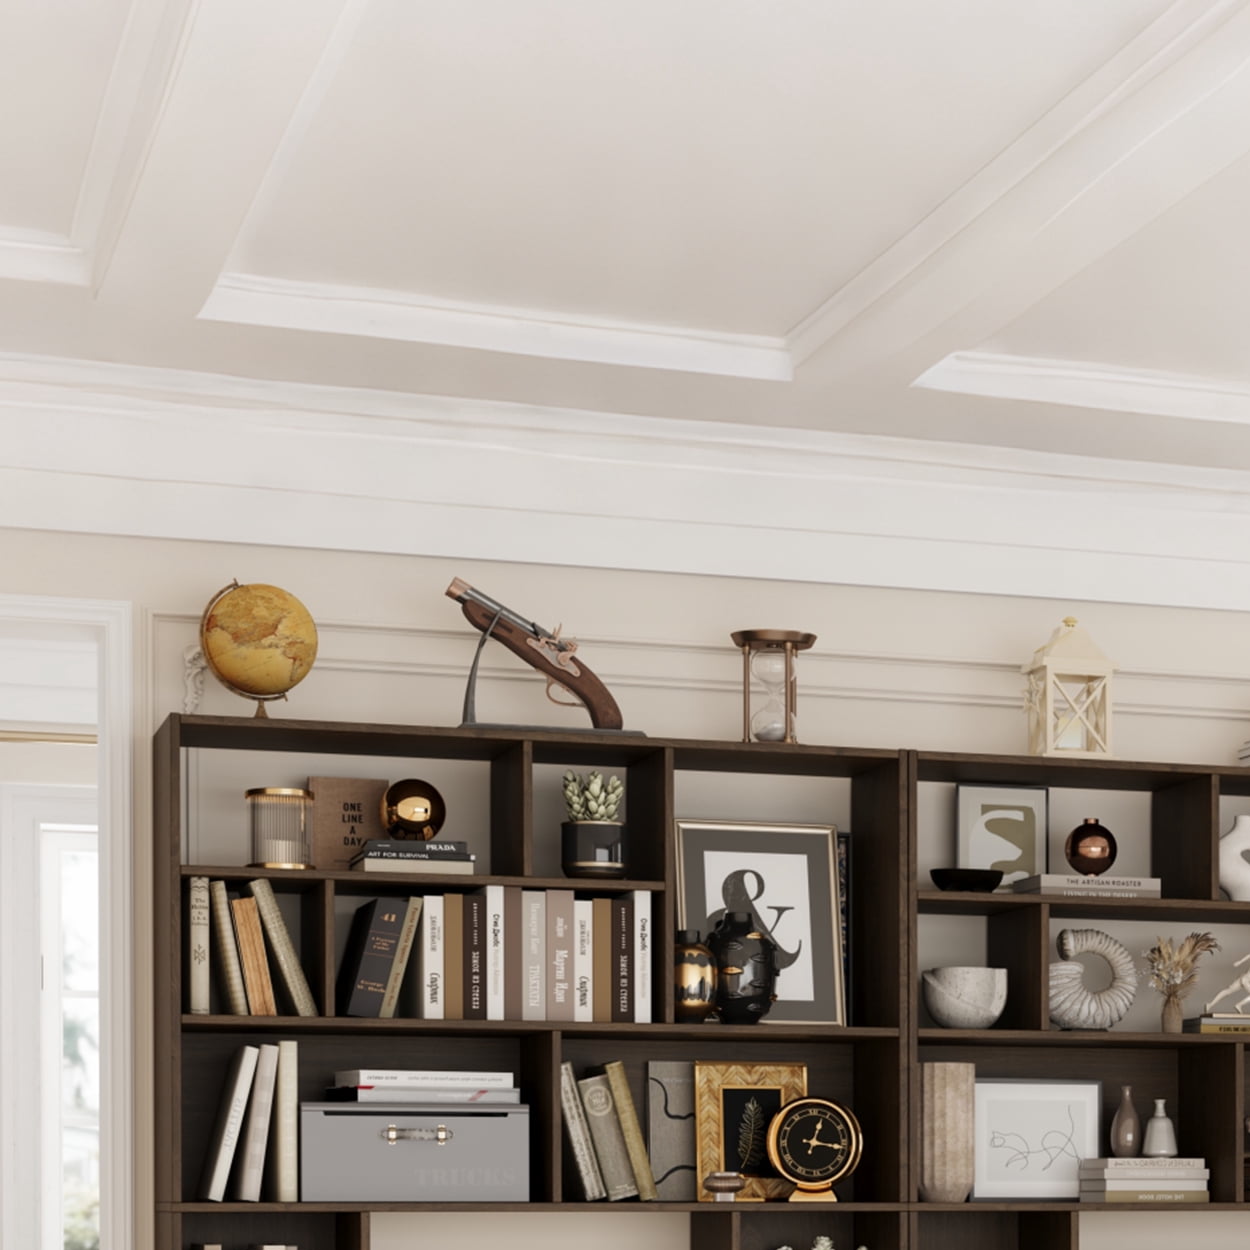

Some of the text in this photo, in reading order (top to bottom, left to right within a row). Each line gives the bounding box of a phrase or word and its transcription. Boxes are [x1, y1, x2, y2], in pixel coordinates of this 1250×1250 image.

[343, 803, 362, 812] ONE
[342, 814, 363, 824] LINE
[350, 825, 356, 835] A
[343, 836, 362, 846] DAY
[426, 844, 456, 852] PRADA
